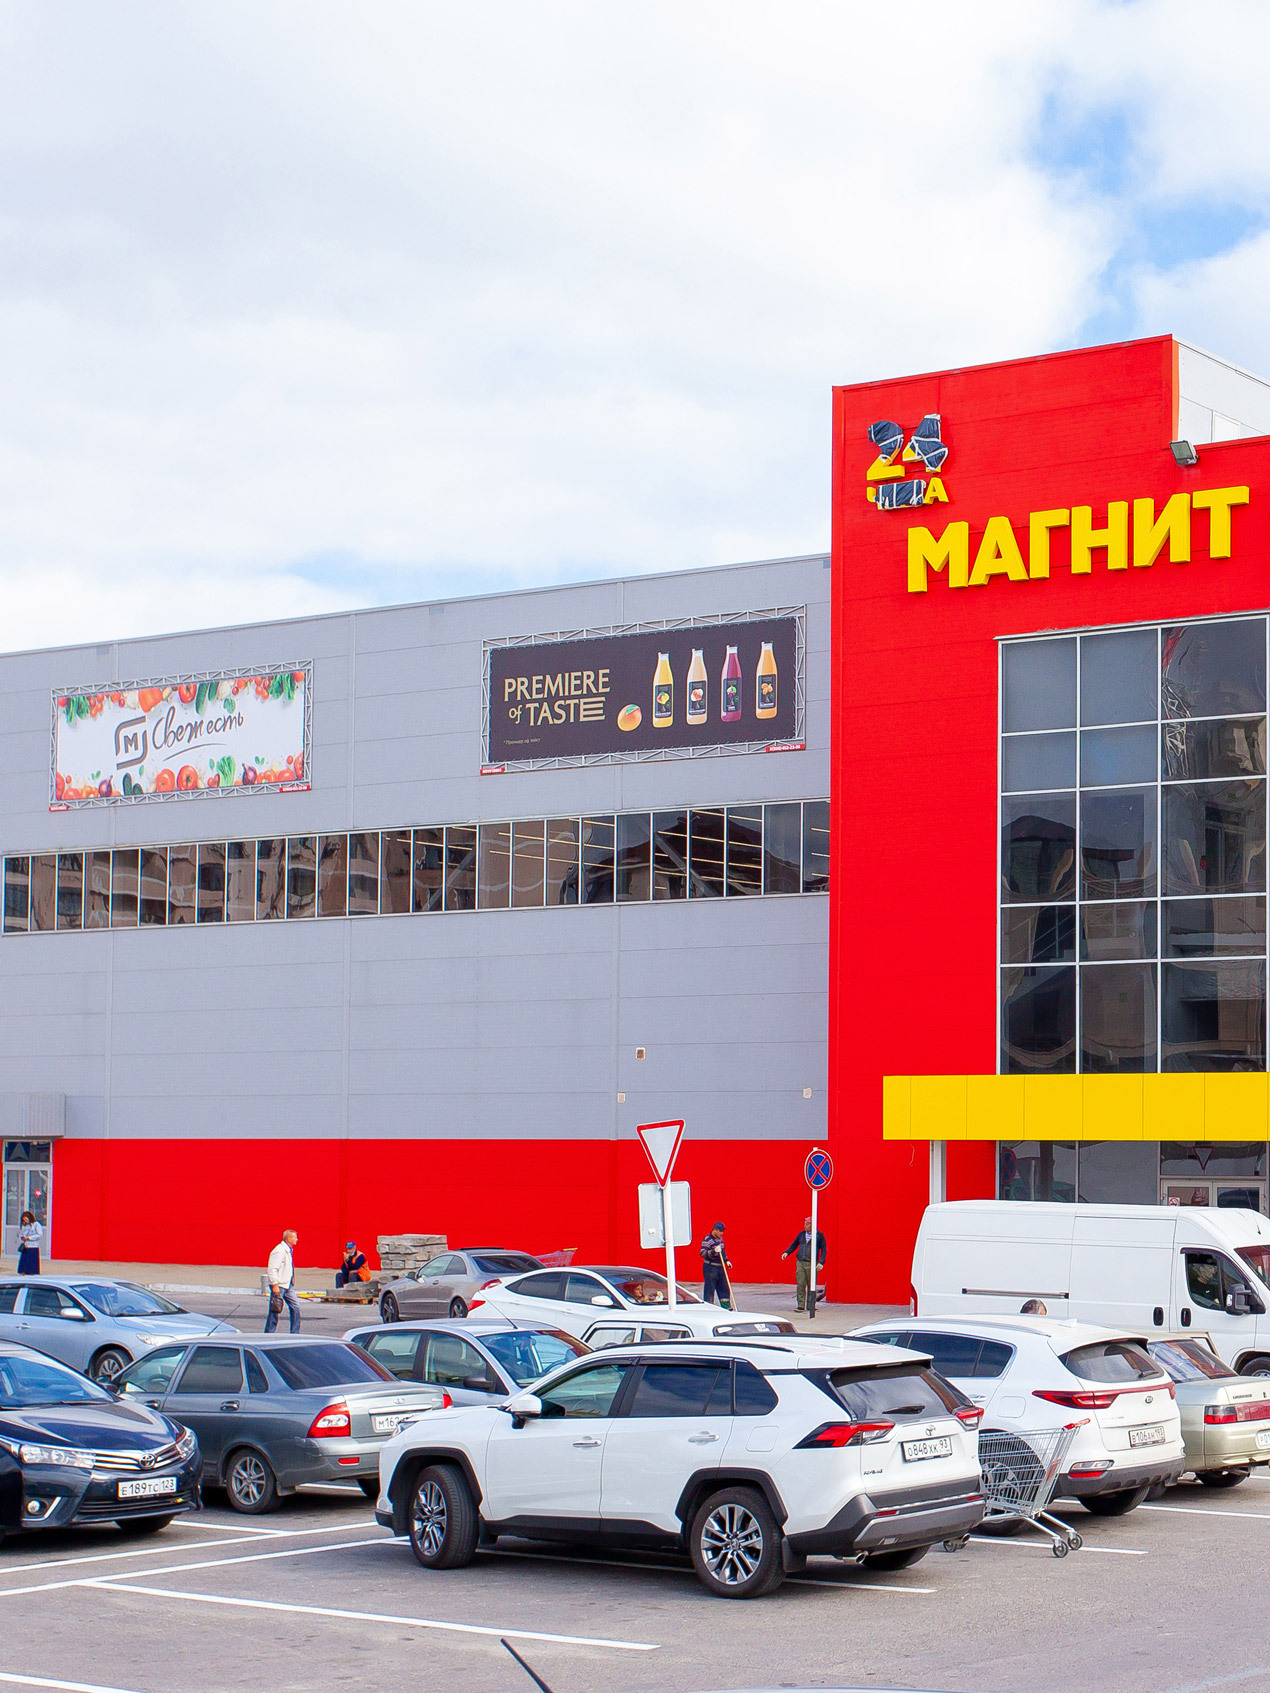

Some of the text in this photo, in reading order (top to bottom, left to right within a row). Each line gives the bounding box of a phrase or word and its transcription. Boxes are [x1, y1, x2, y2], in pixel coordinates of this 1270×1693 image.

[907, 485, 1250, 594] МАГНИТ
[504, 668, 611, 702] PREMIERE
[151, 705, 244, 751] Свежесть
[508, 696, 606, 726] of TASTE
[121, 1479, 174, 1496] Е189ТС 123
